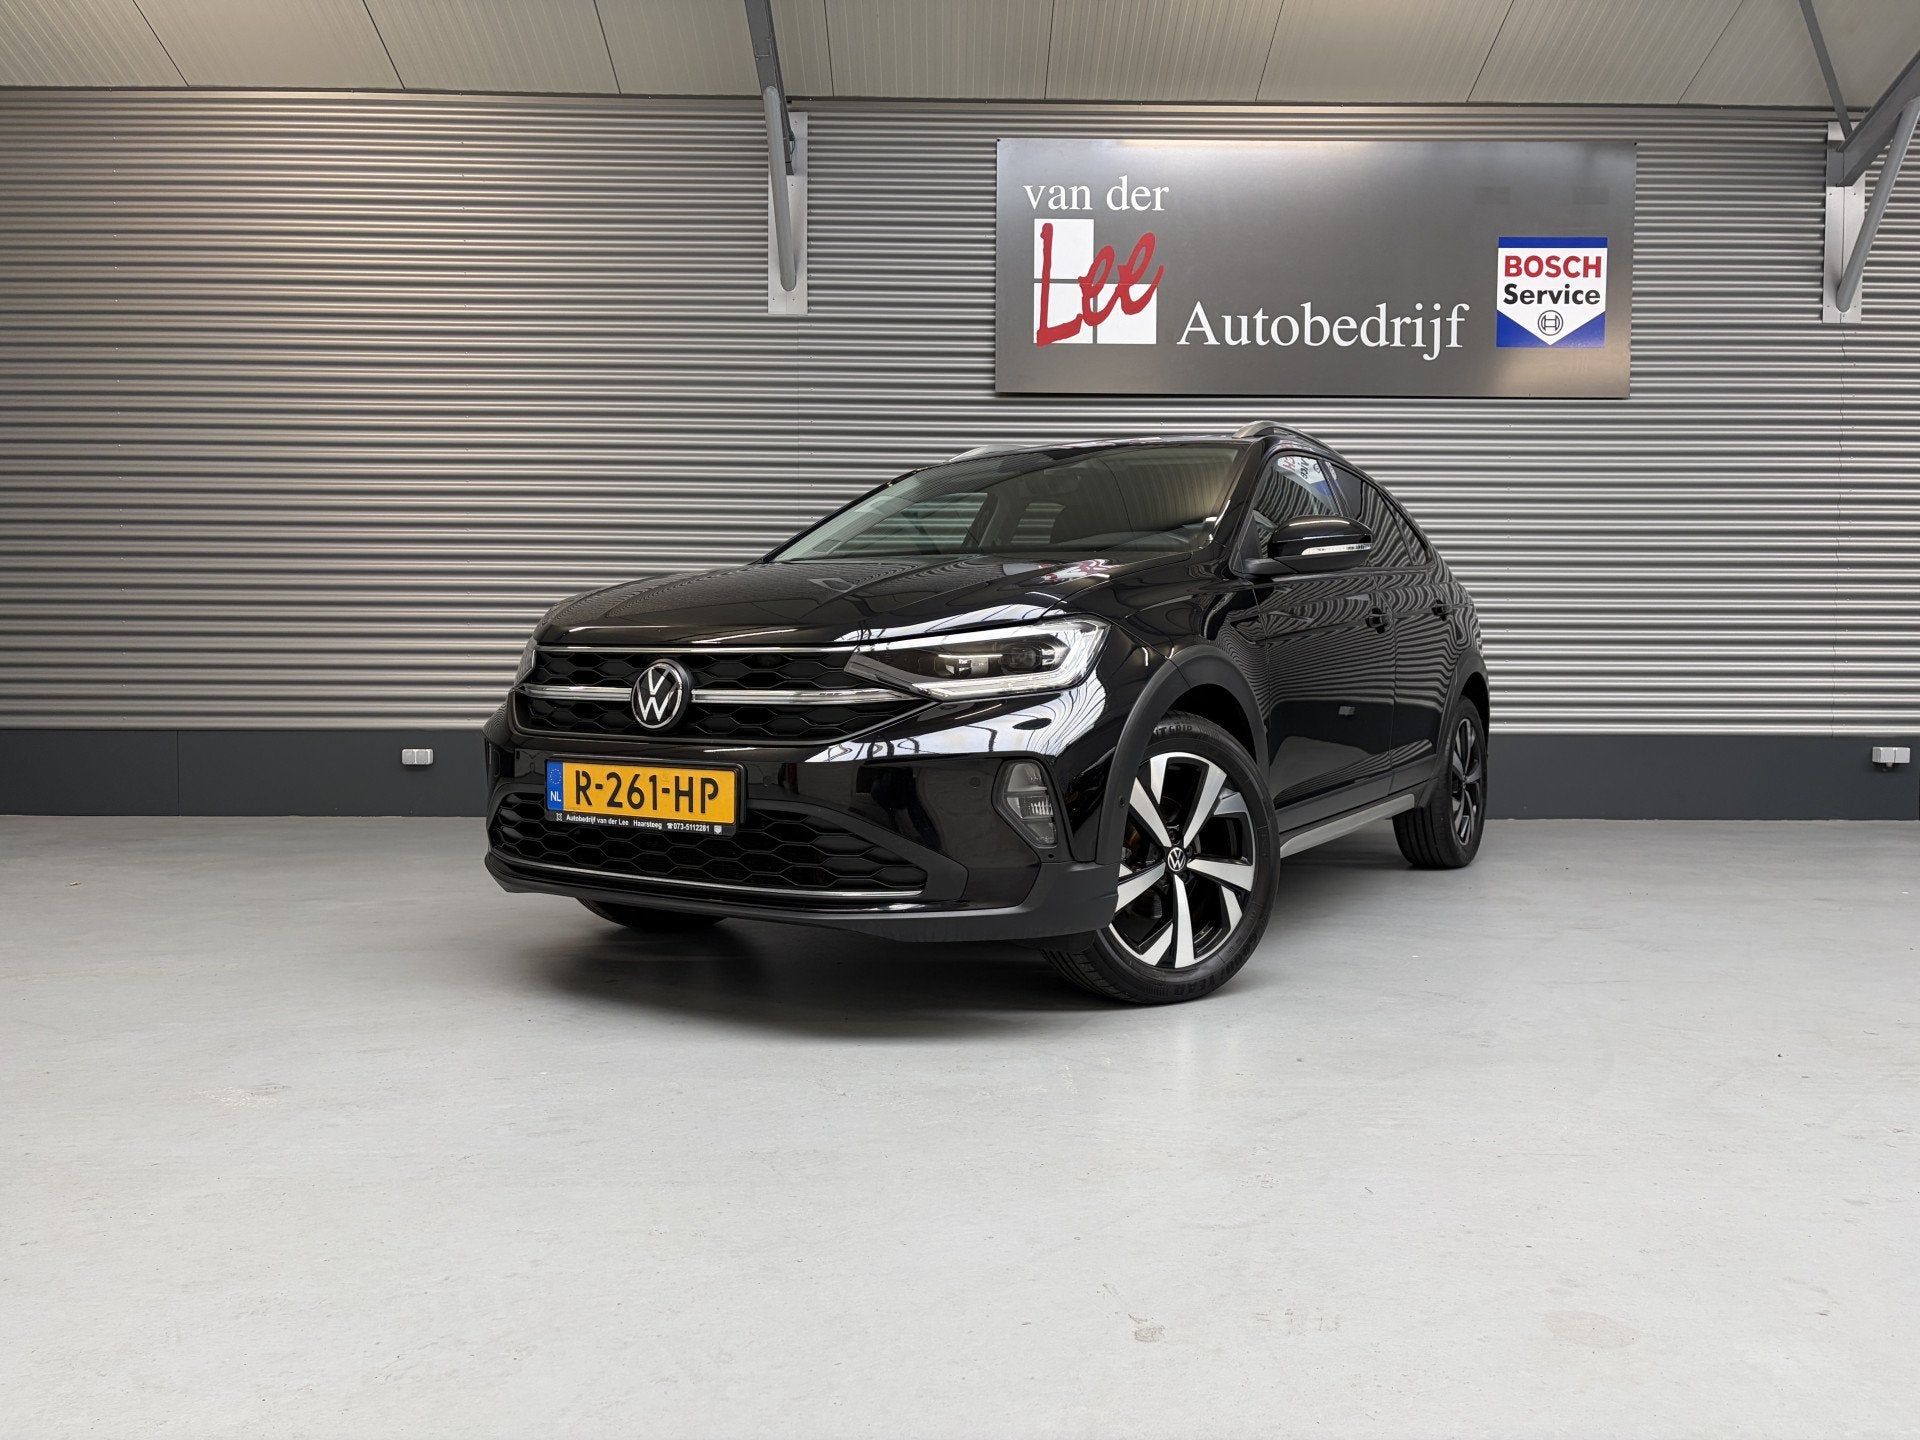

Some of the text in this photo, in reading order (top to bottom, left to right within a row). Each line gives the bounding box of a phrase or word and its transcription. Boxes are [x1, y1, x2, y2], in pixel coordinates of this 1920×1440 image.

[1023, 175, 1170, 211] van der
[1503, 255, 1602, 279] BOSCH
[1036, 222, 1165, 348] Lee
[1503, 283, 1601, 306] Service
[1176, 300, 1471, 361] Autobedrijf
[550, 790, 562, 802] NL
[575, 769, 719, 814] R-261-HP
[566, 813, 596, 825] Autobedrijf
[608, 817, 617, 825] der
[618, 818, 629, 826] Lee
